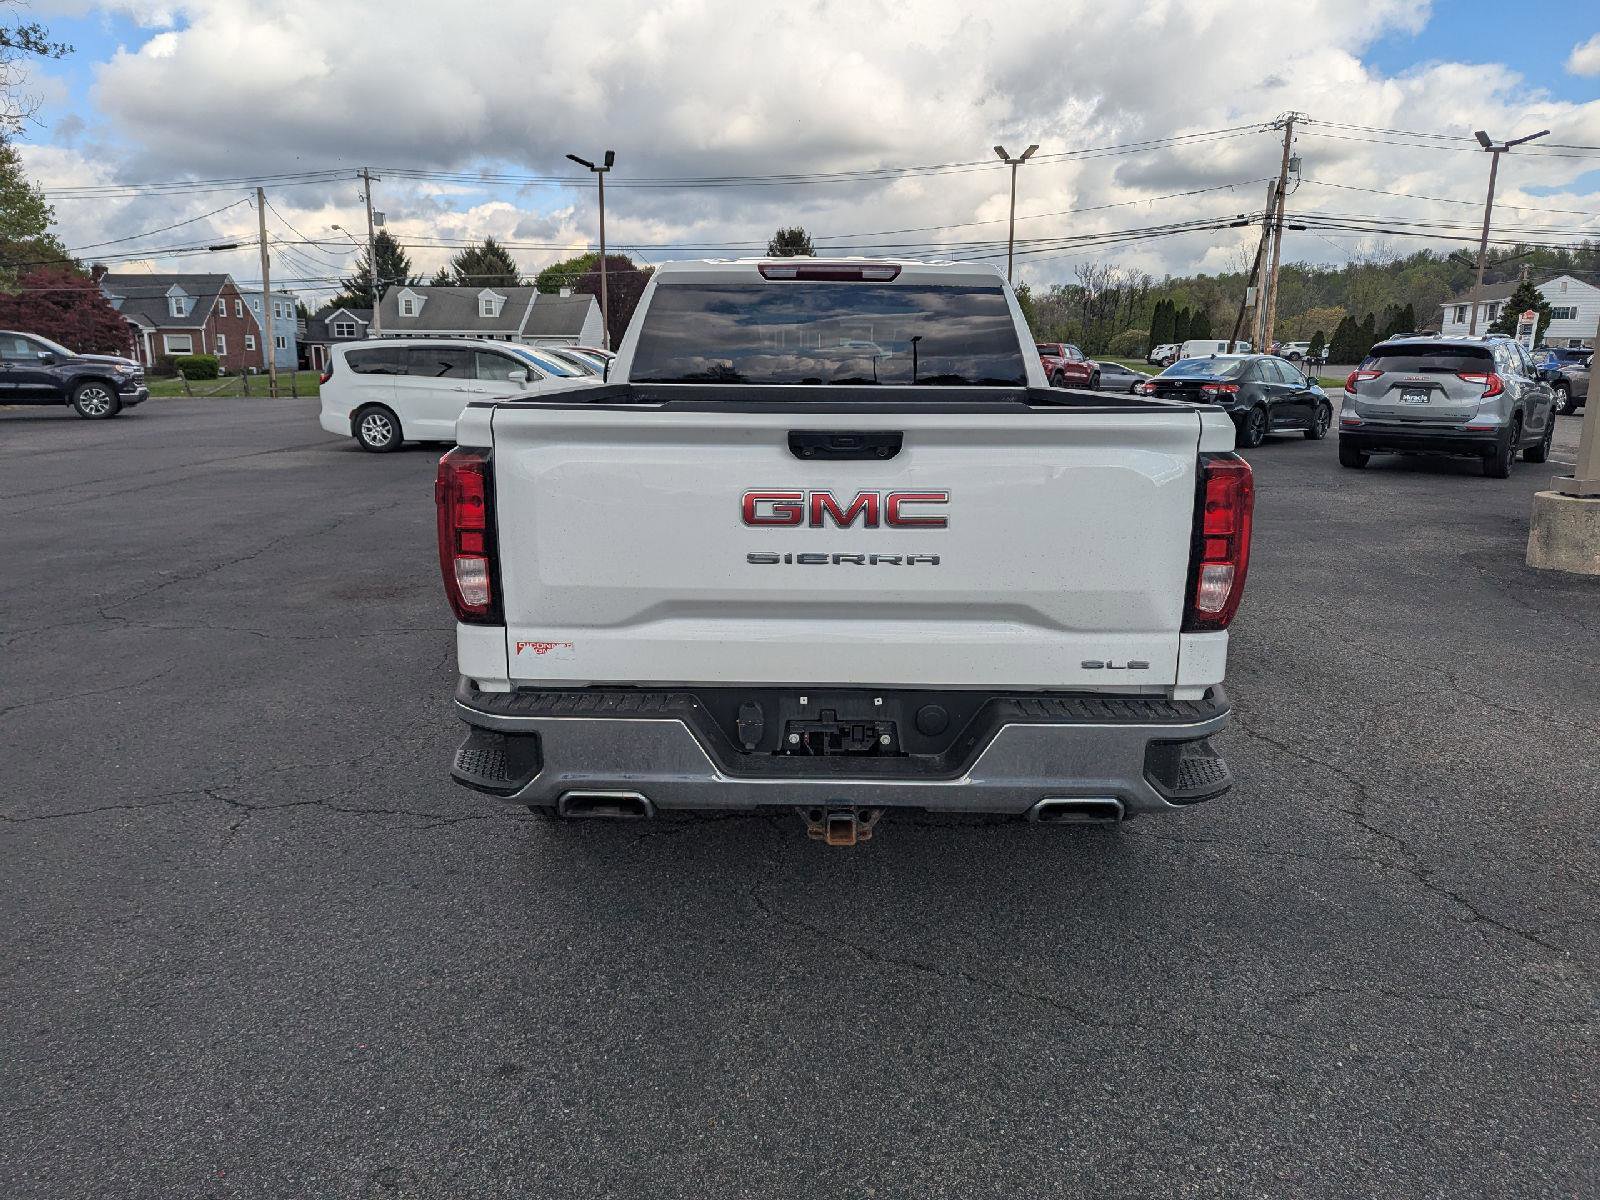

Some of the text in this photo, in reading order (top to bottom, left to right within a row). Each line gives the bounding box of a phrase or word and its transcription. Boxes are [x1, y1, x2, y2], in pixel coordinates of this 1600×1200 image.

[742, 490, 949, 529] GMC
[746, 552, 941, 566] SIERRA
[1081, 660, 1150, 670] SLE
